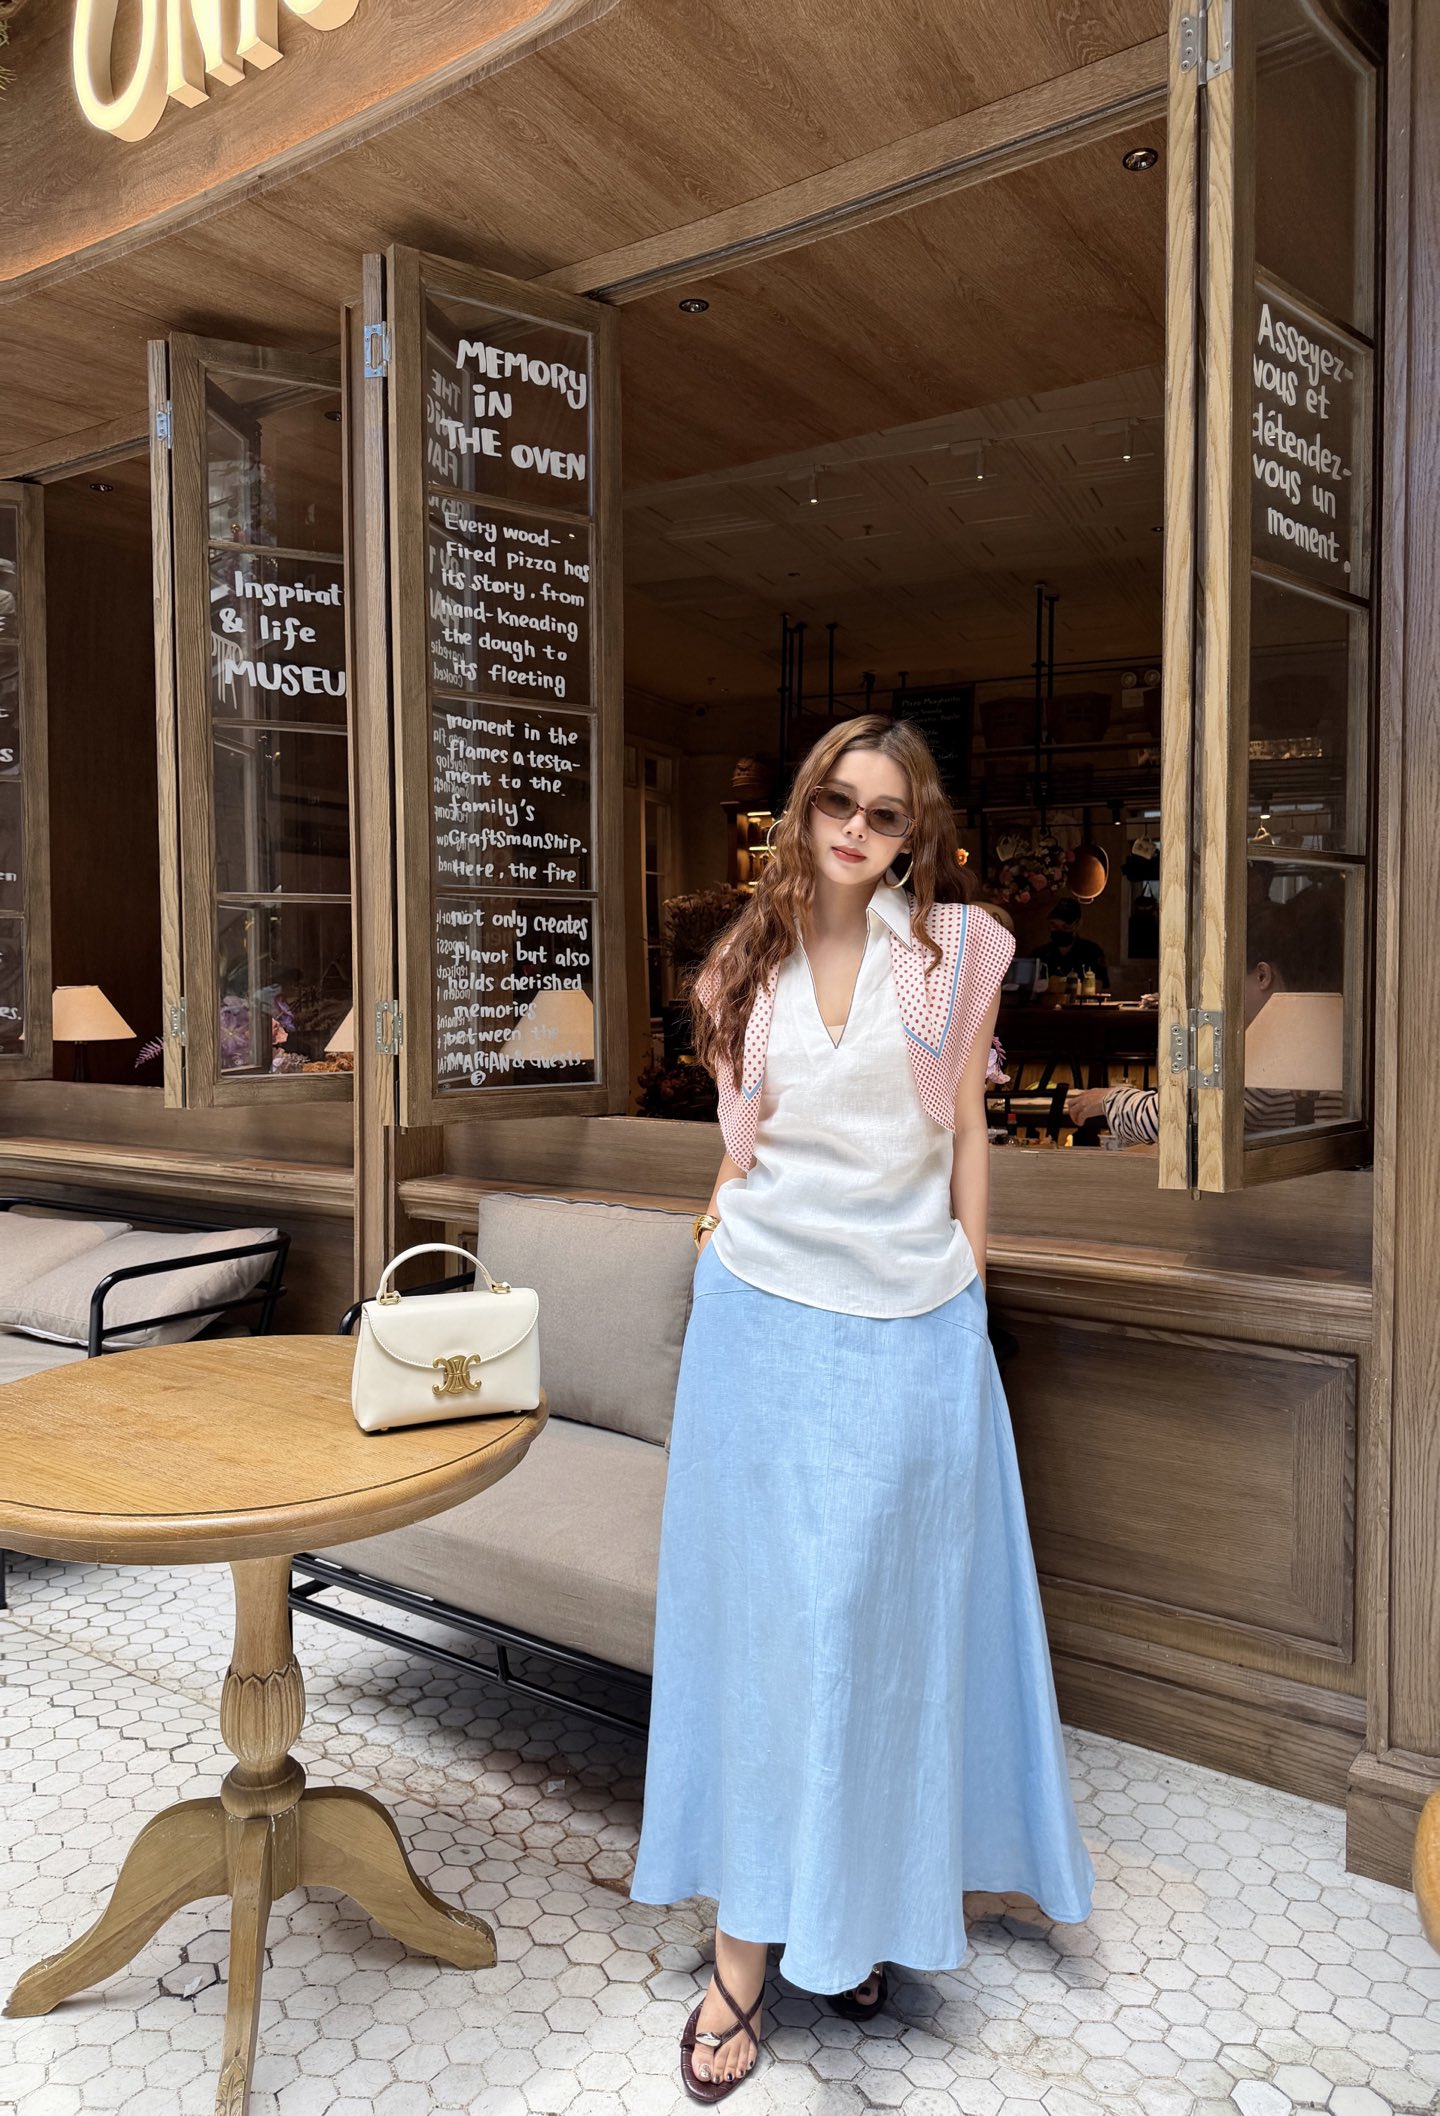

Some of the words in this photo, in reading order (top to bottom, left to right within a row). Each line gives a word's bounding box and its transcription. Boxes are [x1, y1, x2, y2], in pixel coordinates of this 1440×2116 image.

[1258, 303, 1354, 386] Asseyez-
[456, 339, 587, 410] MEMORY
[1253, 354, 1298, 406] vous
[1306, 385, 1329, 419] et
[440, 418, 502, 457] THE
[511, 444, 586, 481] OVEN
[1253, 453, 1301, 505] vous
[1313, 484, 1336, 519] un
[444, 511, 497, 543] Every
[503, 529, 561, 547] wood-
[446, 541, 496, 567] Fired
[507, 551, 557, 573] pizza
[564, 560, 590, 583] has
[234, 571, 343, 607] Inspirat
[441, 568, 466, 590] its
[540, 583, 585, 607] from
[219, 608, 246, 633] &
[260, 615, 317, 650] life
[442, 628, 472, 645] the
[479, 633, 535, 663] dough
[542, 645, 568, 661] to
[453, 658, 477, 681] its
[488, 664, 566, 698] fleeting
[446, 714, 515, 737] moment
[524, 723, 540, 741] in
[548, 727, 578, 746] the
[446, 740, 508, 764] flames
[513, 753, 524, 766] a
[445, 770, 491, 787] ment
[499, 774, 521, 789] to
[529, 777, 562, 793] the
[449, 793, 535, 827] family's
[508, 862, 537, 880] the
[542, 862, 577, 883] fire
[451, 909, 485, 927] not
[492, 910, 527, 938] only
[534, 915, 588, 940] creates
[451, 943, 509, 966] flavor
[516, 941, 547, 964] but
[556, 948, 590, 967] also
[448, 973, 494, 992] holds
[501, 973, 582, 991] cherished
[453, 1001, 537, 1020] memories
[445, 1028, 521, 1045] between
[530, 1024, 559, 1040] the
[512, 1048, 525, 1069] &
